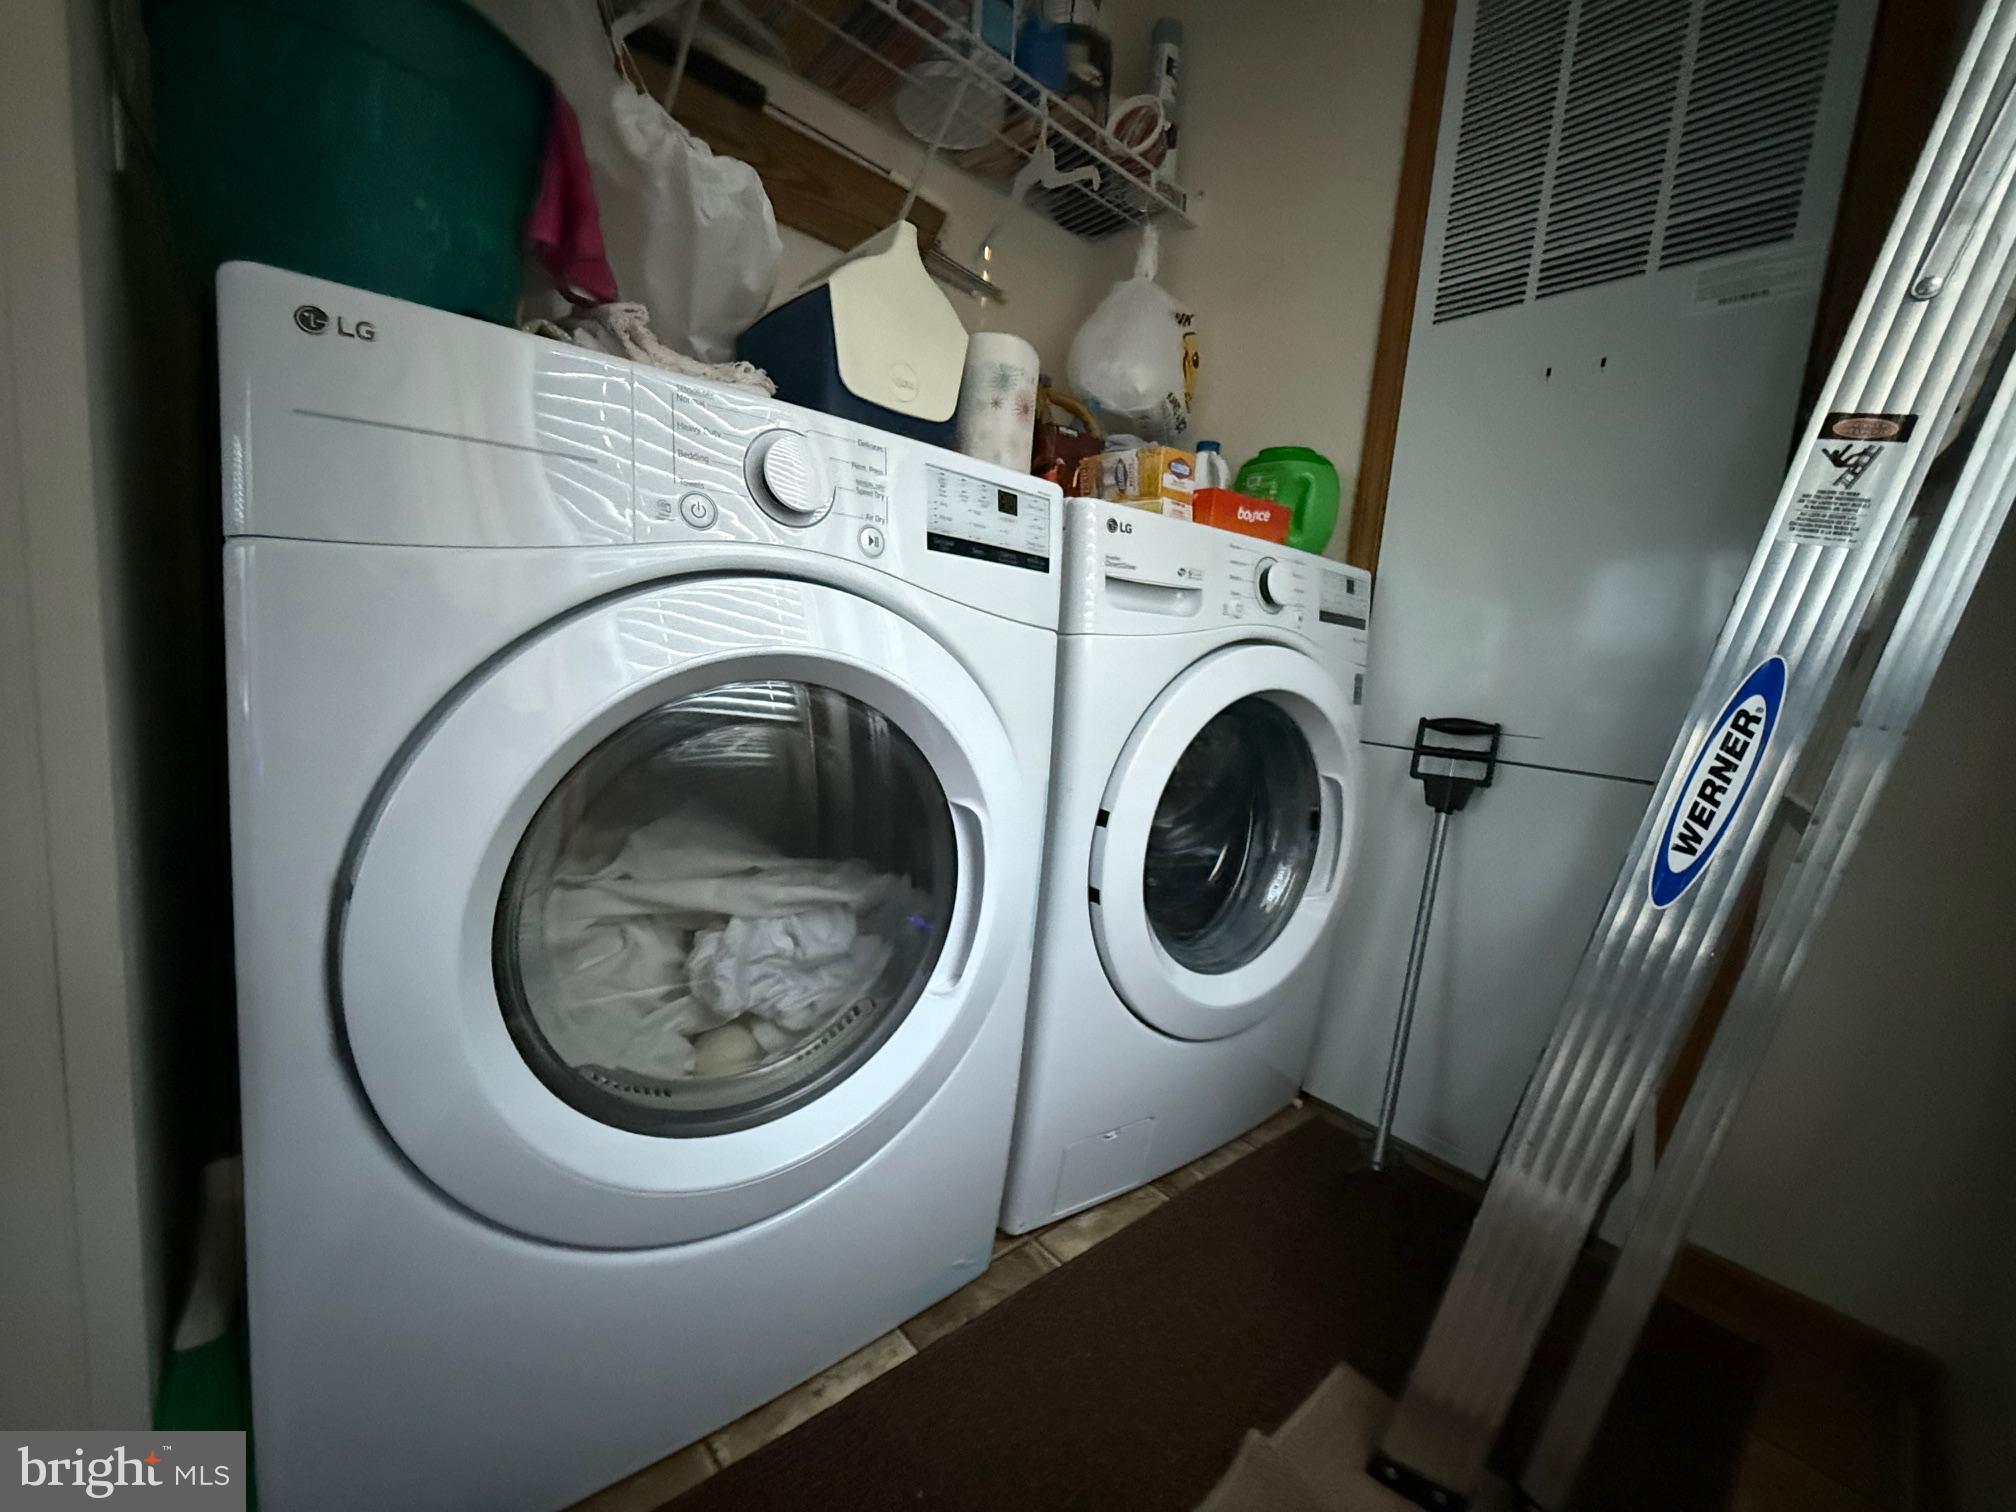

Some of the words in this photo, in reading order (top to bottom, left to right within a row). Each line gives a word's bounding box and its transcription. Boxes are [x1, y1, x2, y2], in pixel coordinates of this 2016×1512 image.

[337, 316, 376, 341] LG
[677, 448, 709, 465] Bedding
[1237, 506, 1271, 523] bounce
[1119, 522, 1133, 534] LG
[1671, 707, 1763, 857] WERNER
